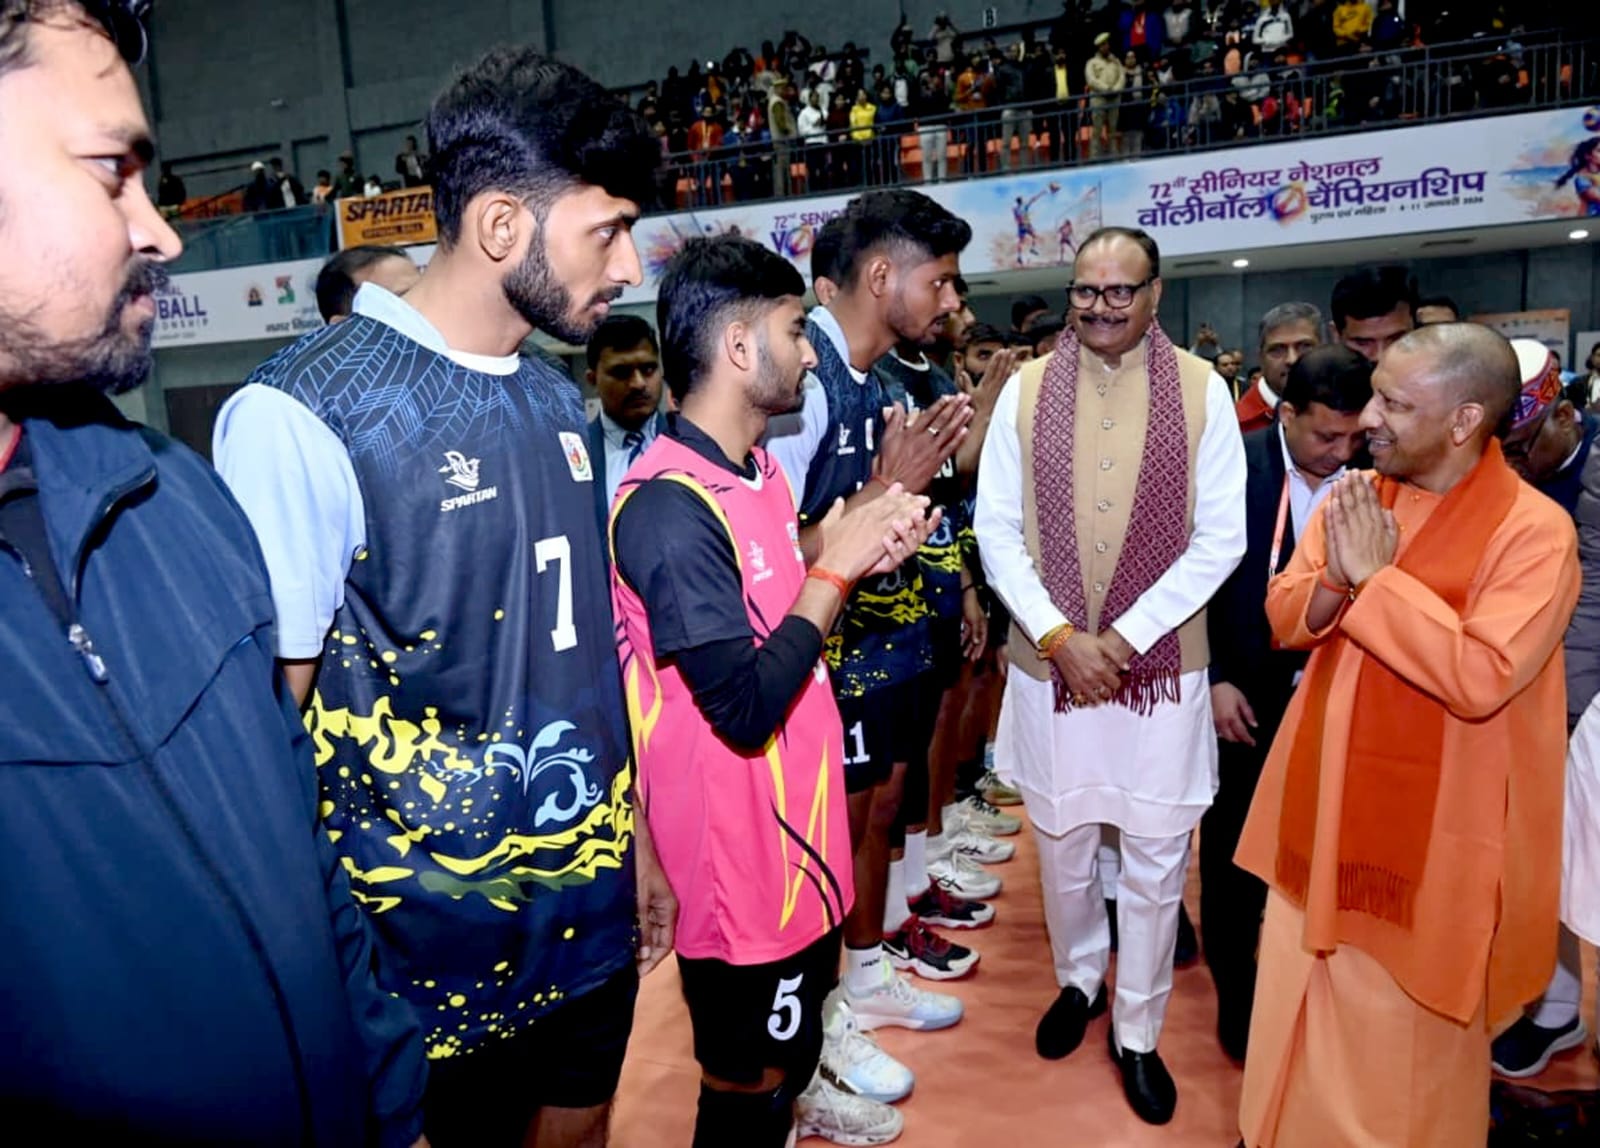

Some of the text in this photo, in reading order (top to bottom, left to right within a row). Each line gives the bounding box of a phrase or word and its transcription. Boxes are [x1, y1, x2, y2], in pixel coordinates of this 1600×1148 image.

[1188, 168, 1283, 195] सीनियर
[1287, 157, 1383, 188] नेशनल
[346, 191, 435, 222] SPARTA
[1137, 167, 1488, 228] वॉलीबॉल चैंपियनशिप
[158, 295, 207, 319] BALL
[440, 486, 497, 512] SPARTAN
[534, 535, 578, 652] 7
[767, 973, 804, 1041] 5
